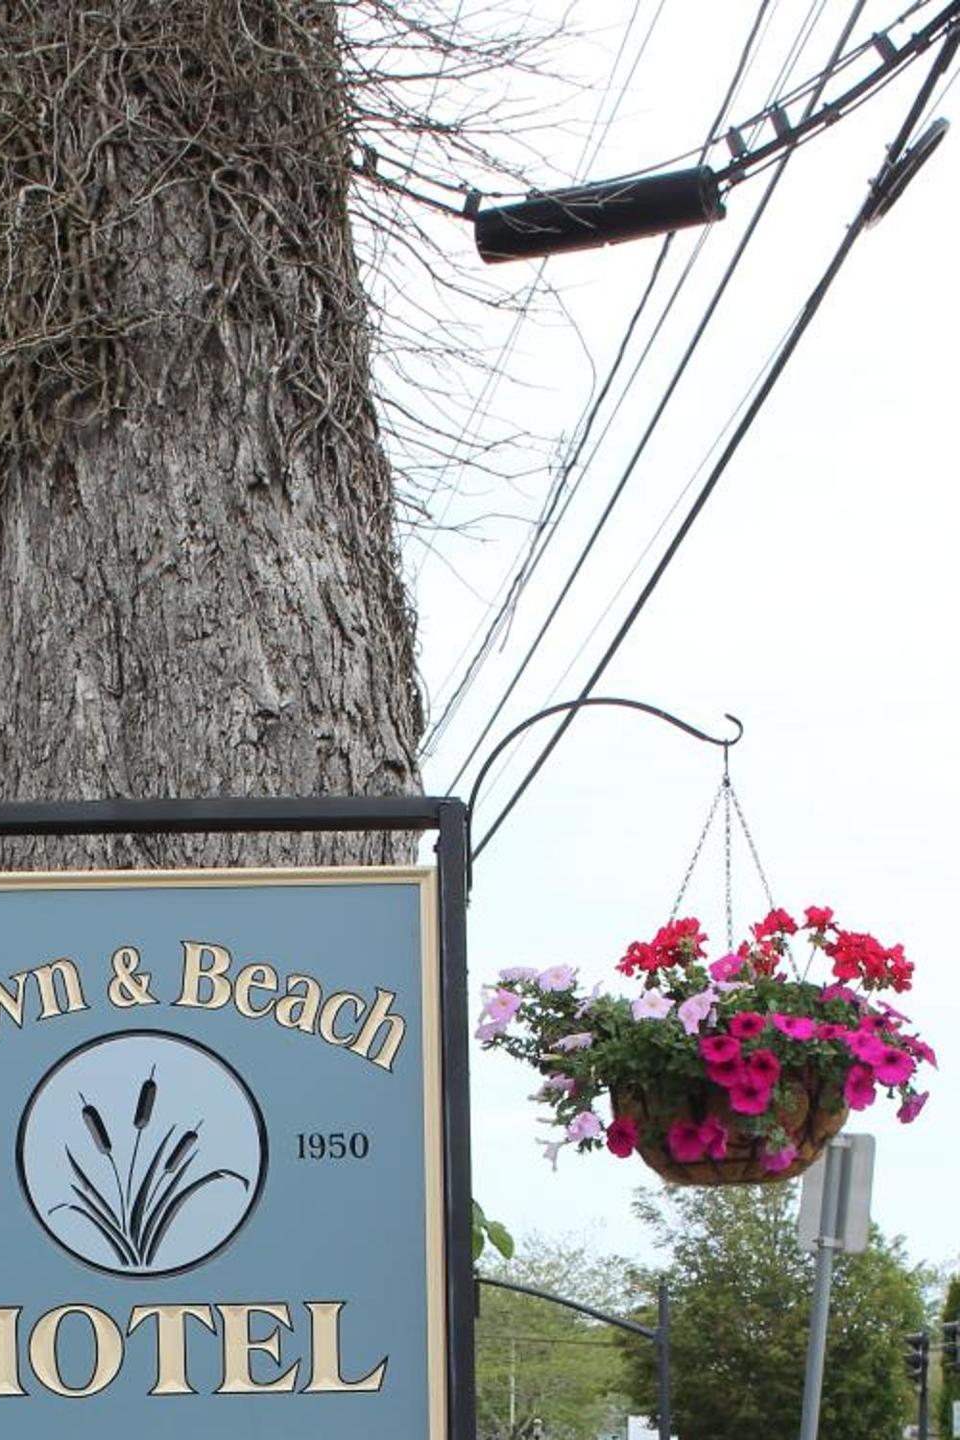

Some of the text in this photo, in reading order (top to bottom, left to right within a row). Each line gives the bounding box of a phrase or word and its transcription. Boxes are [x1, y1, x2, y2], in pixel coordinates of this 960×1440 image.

[106, 945, 160, 1008] &
[171, 939, 407, 1073] Beach
[296, 1132, 371, 1161] 1950
